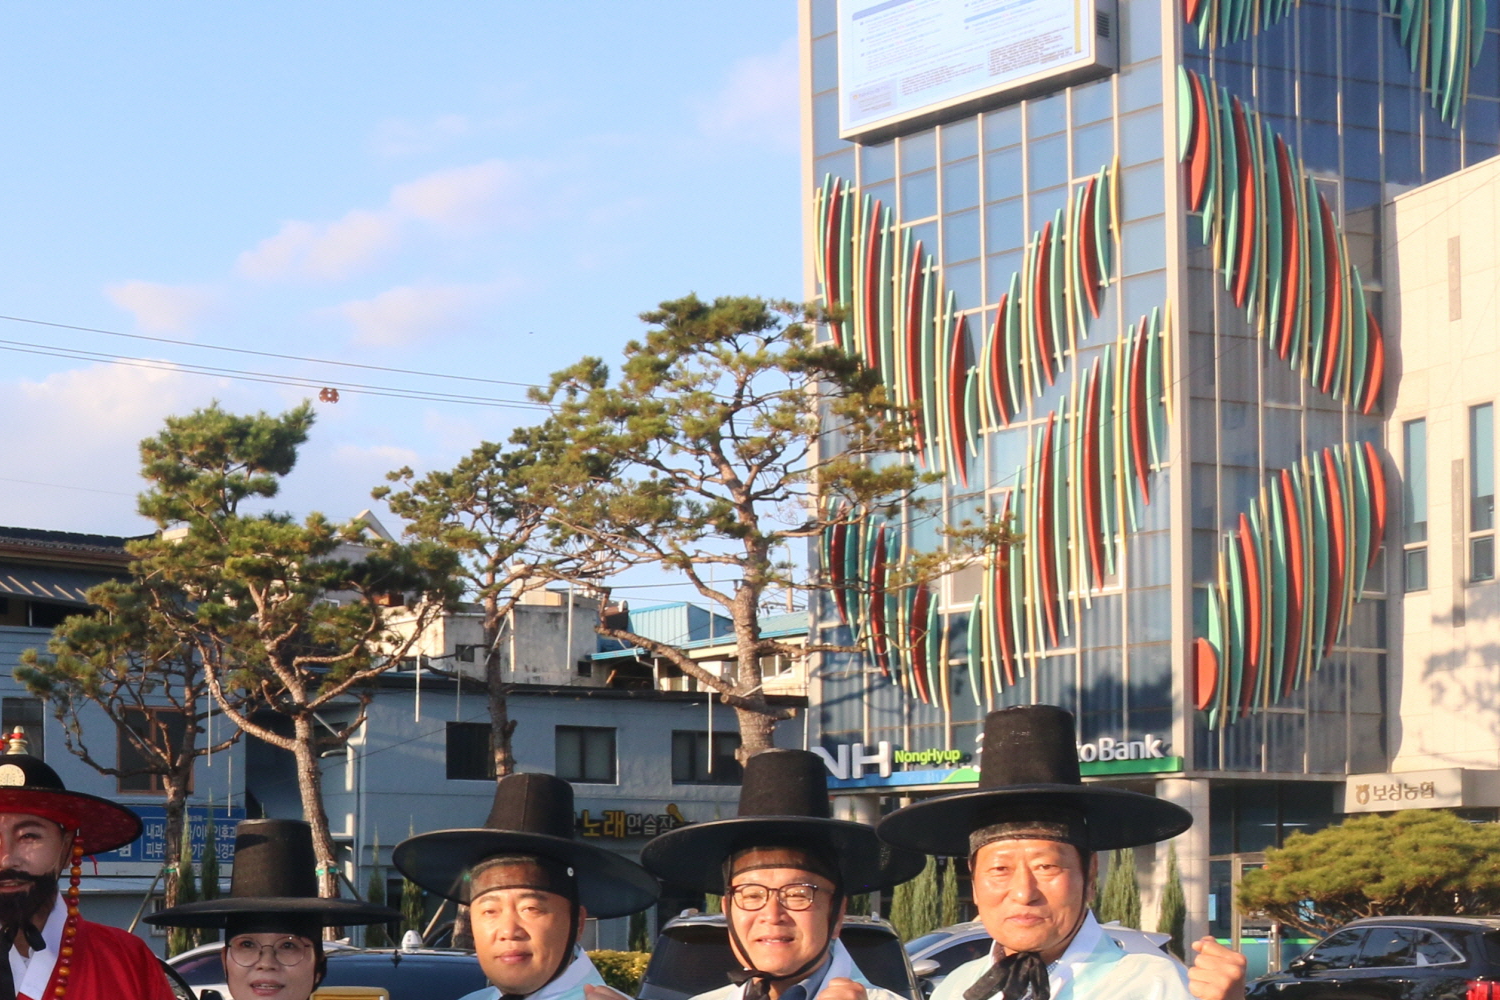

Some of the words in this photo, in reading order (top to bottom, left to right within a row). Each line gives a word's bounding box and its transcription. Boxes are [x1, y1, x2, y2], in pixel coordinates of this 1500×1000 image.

[811, 741, 891, 779] NH
[895, 748, 961, 765] NongHyup
[1373, 781, 1435, 801] 보성농협
